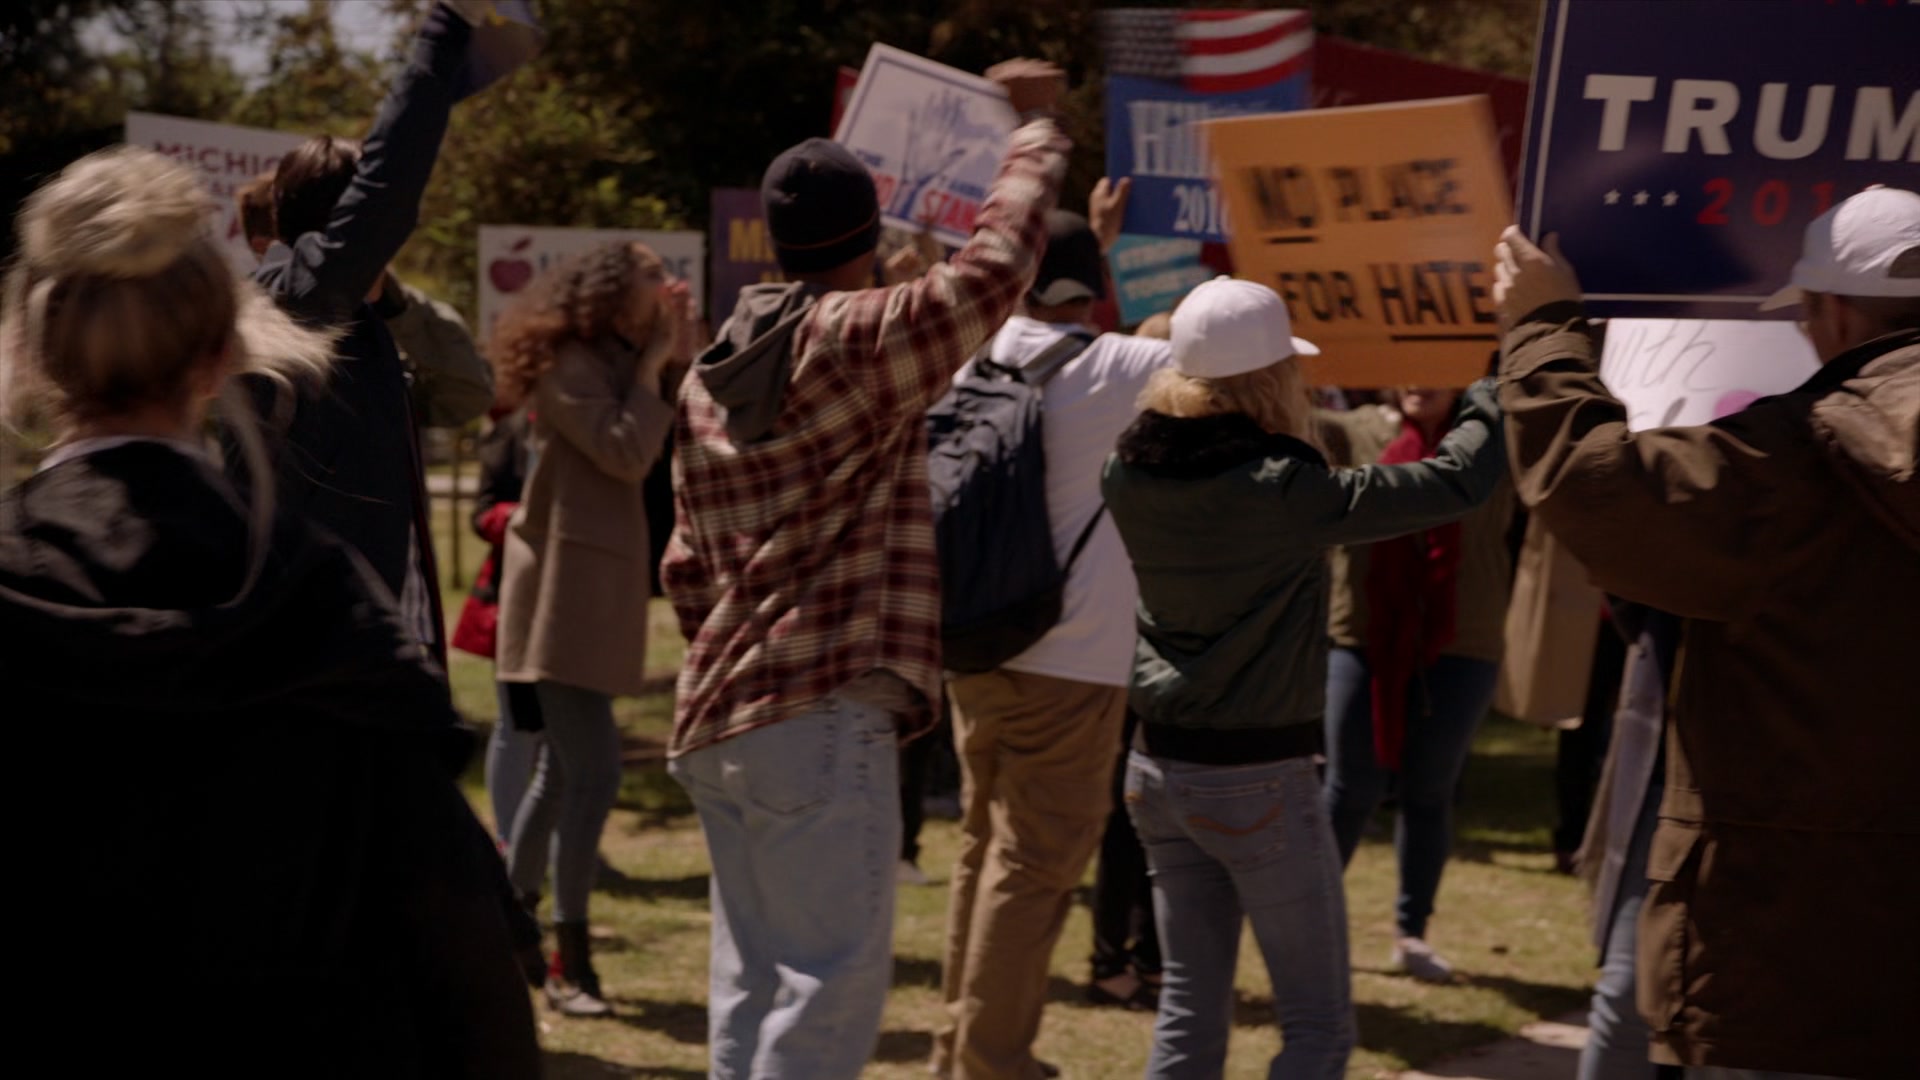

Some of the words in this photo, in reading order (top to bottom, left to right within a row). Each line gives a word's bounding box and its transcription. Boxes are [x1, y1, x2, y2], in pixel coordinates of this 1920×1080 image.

[1242, 165, 1317, 231] NO
[1325, 160, 1467, 221] PLACE
[1696, 178, 1840, 225] 201
[1277, 269, 1363, 322] FOR
[1368, 262, 1497, 326] HATE
